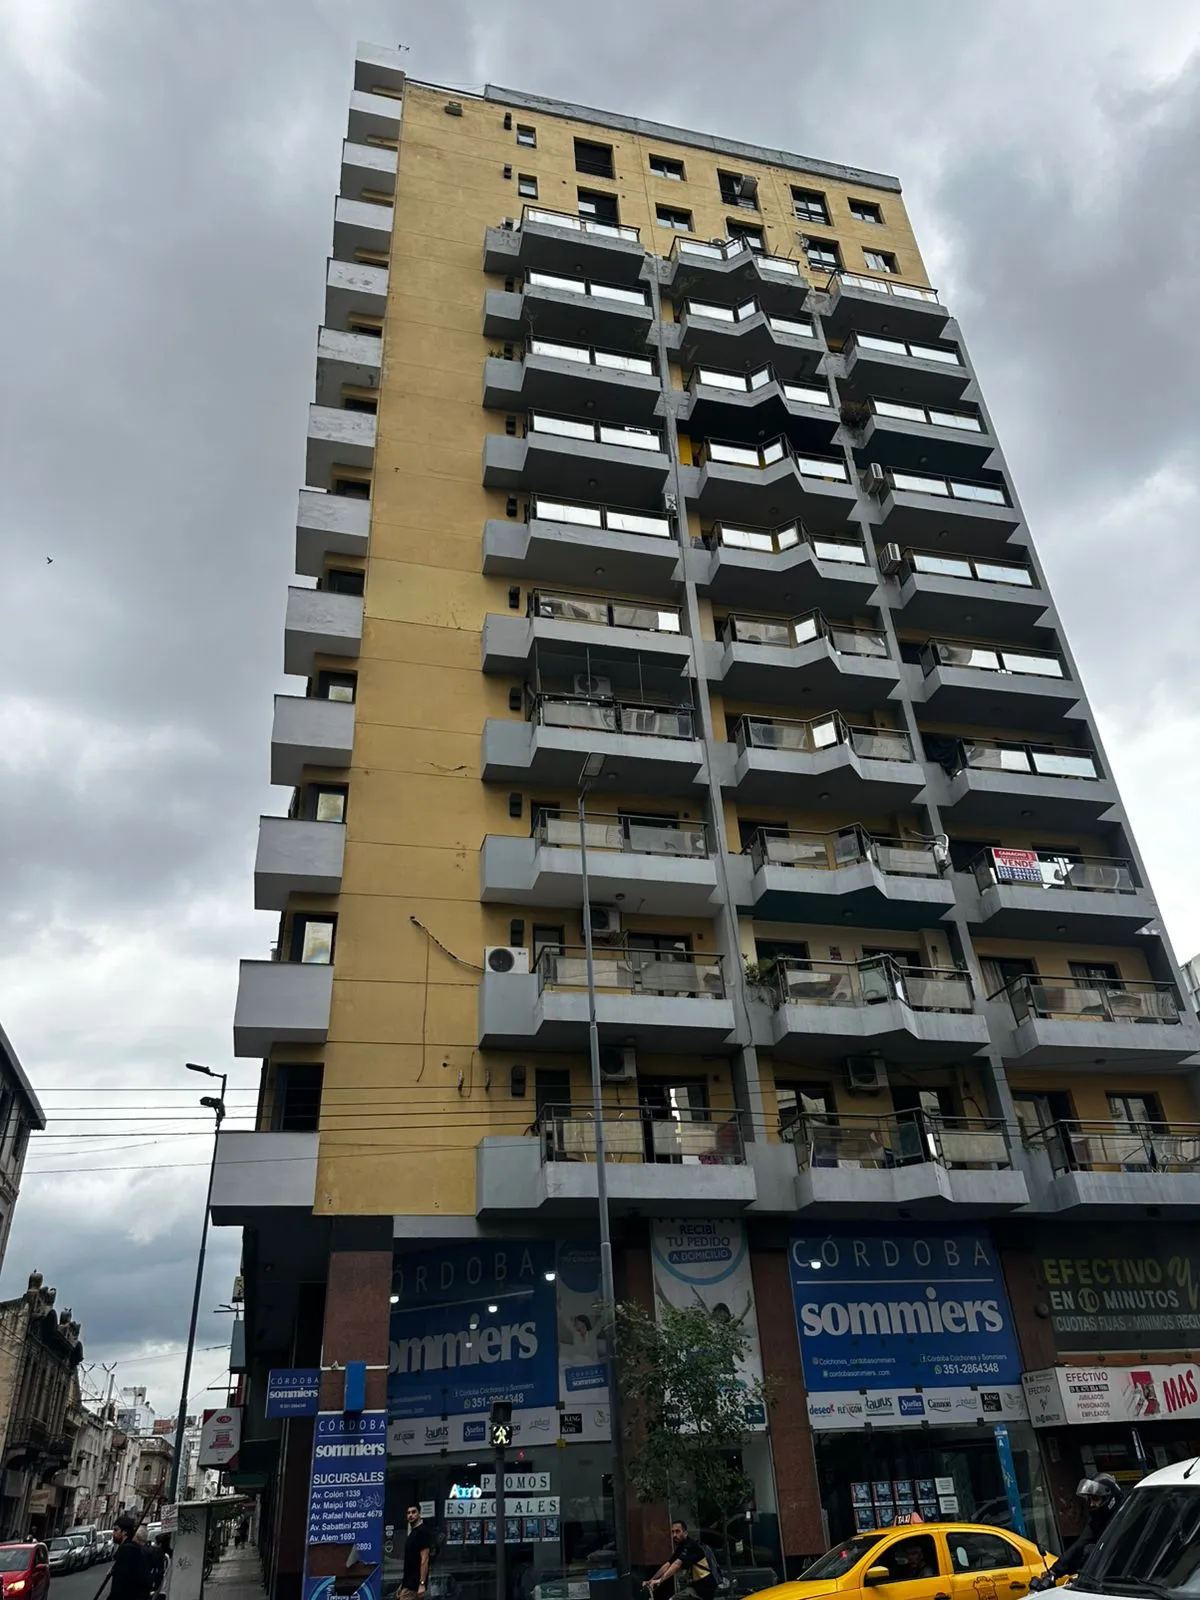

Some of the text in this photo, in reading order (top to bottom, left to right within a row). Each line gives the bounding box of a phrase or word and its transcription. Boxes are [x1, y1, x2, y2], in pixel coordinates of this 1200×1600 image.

[1001, 858, 1034, 868] VENDE
[666, 1236, 731, 1247] TU PEDIDO
[681, 1250, 728, 1261] DOMICILIO
[792, 1234, 990, 1267] CÓRDOBA
[393, 1247, 535, 1295] ÓRDOBA
[1042, 1257, 1162, 1285] EFECTIVO
[1049, 1290, 1075, 1310] EN
[1103, 1289, 1180, 1310] MINUTOS
[800, 1286, 1004, 1337] sommiers
[1056, 1315, 1097, 1332] CUOTAS
[943, 1362, 999, 1374] 351-2864348
[271, 1376, 319, 1385] CÓRDOBA
[1066, 1371, 1109, 1382] EFECTIVO
[269, 1387, 319, 1399] sommiers
[318, 1418, 386, 1431] CÓRDOBA
[315, 1438, 385, 1458] sommiers
[313, 1471, 385, 1485] SUCURSALES
[483, 1475, 547, 1489] POMOS
[312, 1489, 361, 1499] Av. Colón 1339
[311, 1502, 322, 1510] Av.
[323, 1501, 344, 1510] Maipú
[345, 1500, 357, 1508] 160
[310, 1510, 383, 1521] Av. Rafael Nuñez 4679
[897, 1514, 912, 1525] TAXI
[321, 1522, 351, 1531] Sabattini
[352, 1521, 368, 1529] 2536
[309, 1532, 356, 1542] Av. Alem 1693
